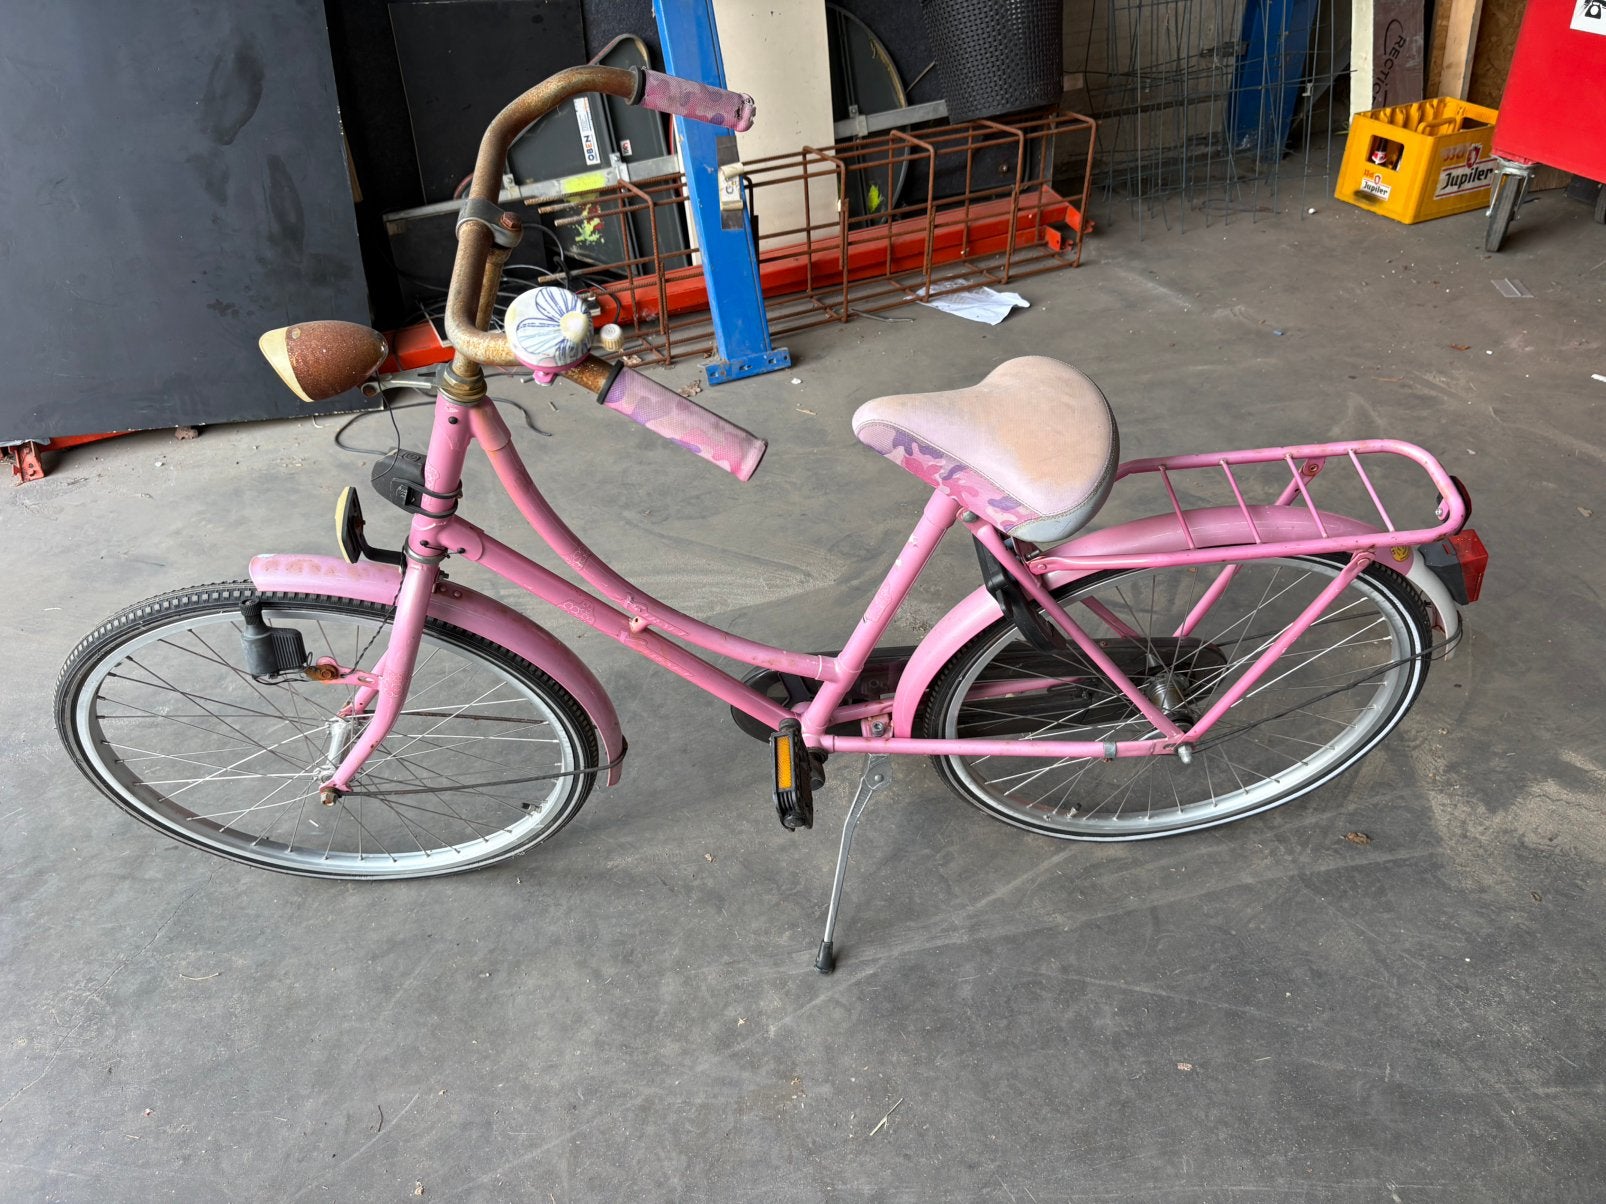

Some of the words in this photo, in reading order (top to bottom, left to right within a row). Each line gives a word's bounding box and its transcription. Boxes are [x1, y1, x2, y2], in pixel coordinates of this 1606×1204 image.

[1372, 35, 1406, 105] RECTIC
[584, 135, 595, 161] OBEN
[1364, 181, 1388, 196] Jupiler
[1441, 167, 1493, 190] Jupiler
